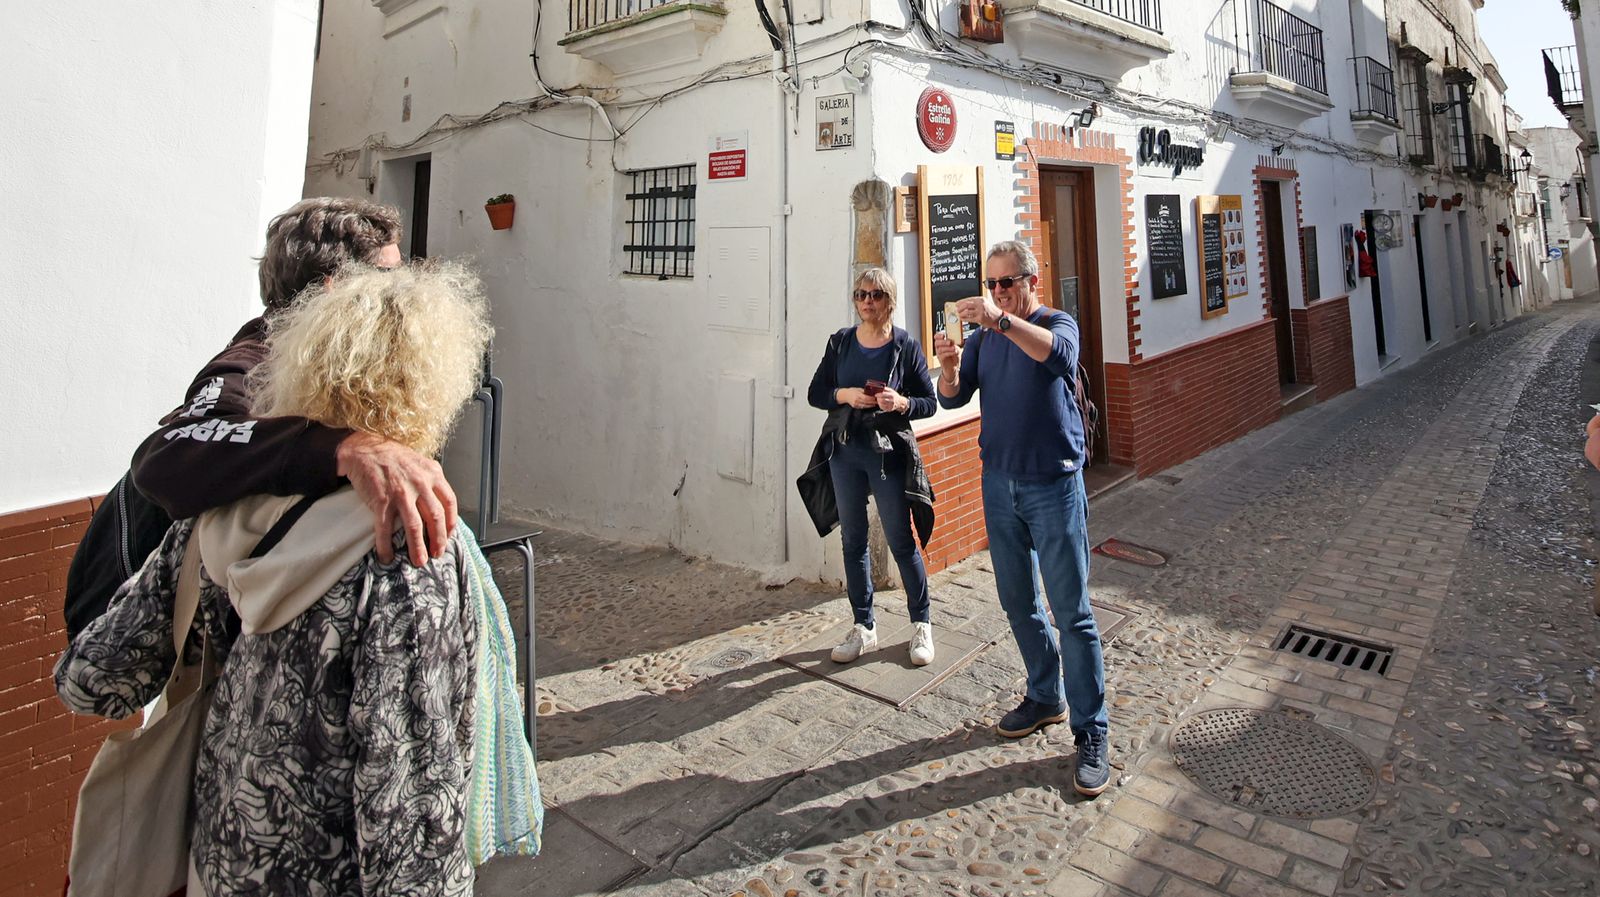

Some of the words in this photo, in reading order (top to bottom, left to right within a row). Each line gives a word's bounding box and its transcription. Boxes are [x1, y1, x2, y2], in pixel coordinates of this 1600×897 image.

[820, 98, 849, 111] GALERIA
[928, 102, 951, 115] Estrella
[841, 117, 848, 125] DE
[928, 112, 951, 125] Galicia
[834, 133, 852, 145] ARTE
